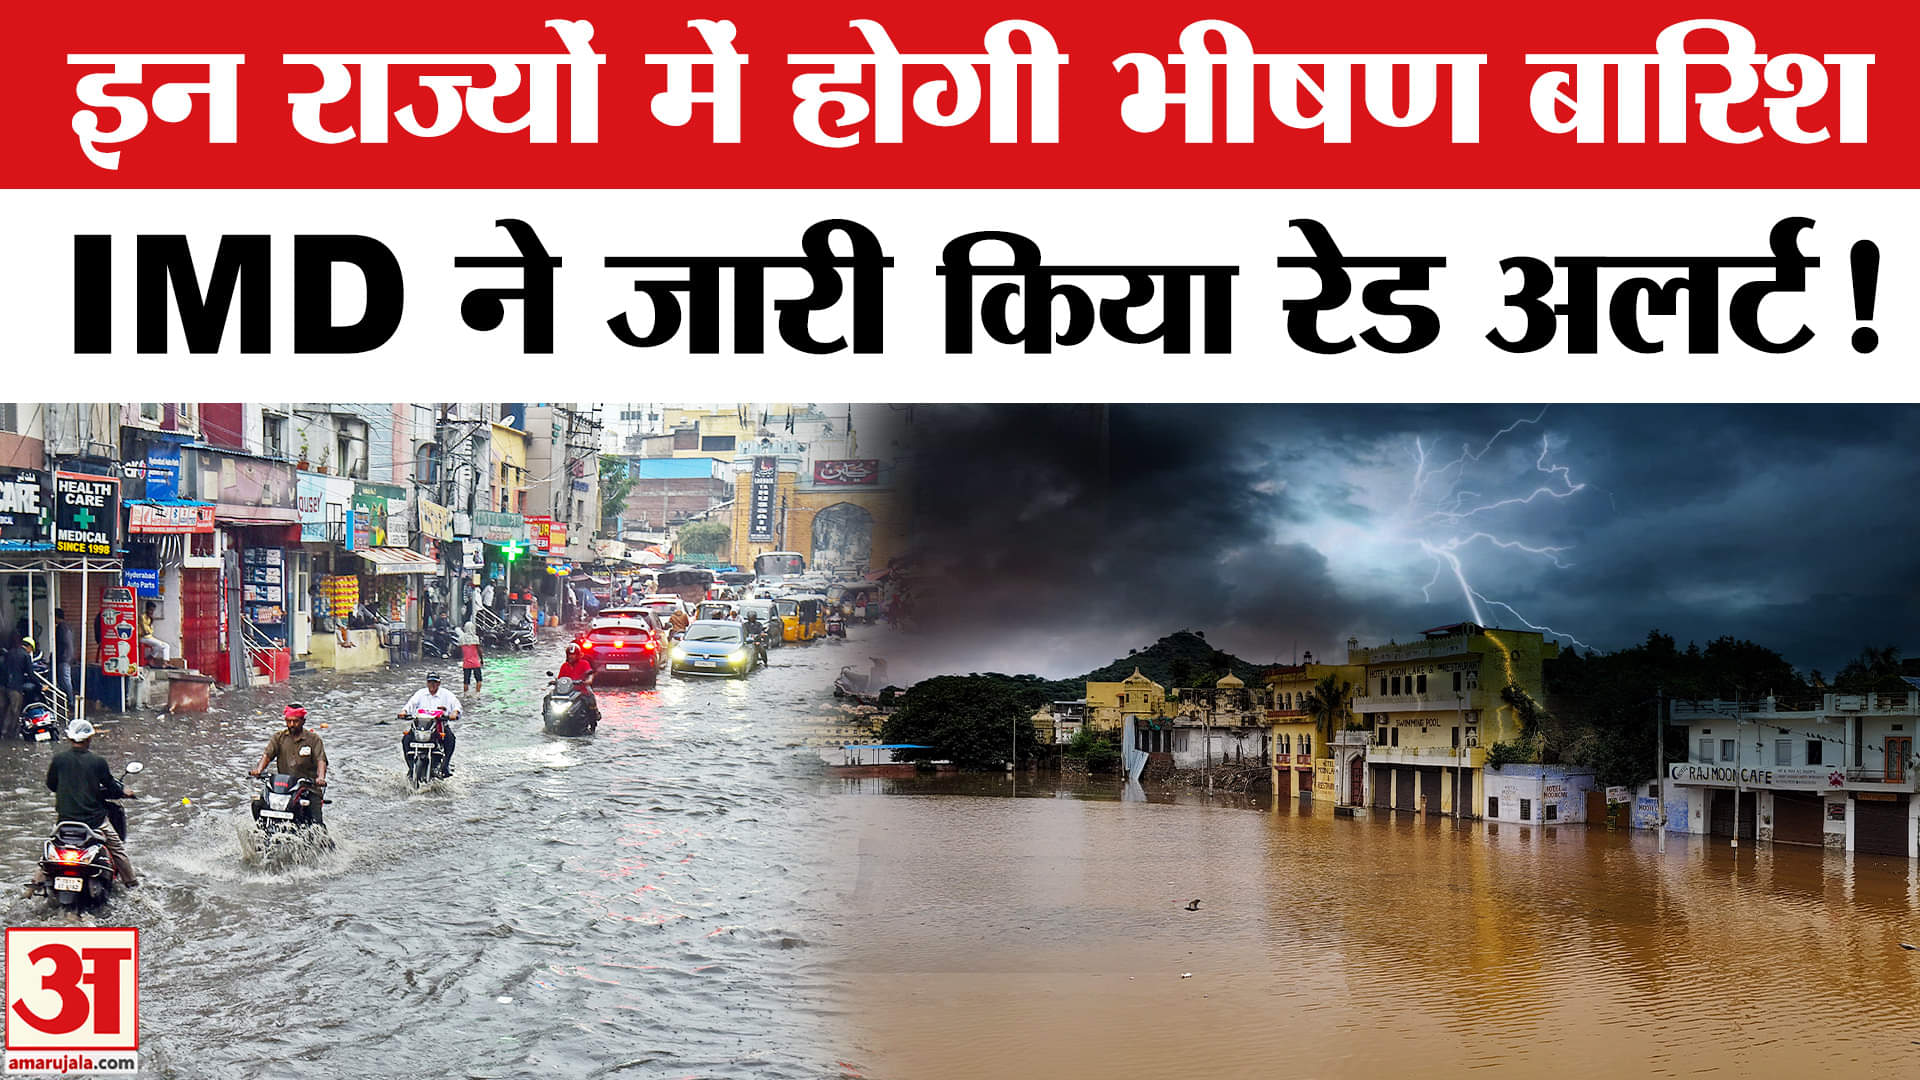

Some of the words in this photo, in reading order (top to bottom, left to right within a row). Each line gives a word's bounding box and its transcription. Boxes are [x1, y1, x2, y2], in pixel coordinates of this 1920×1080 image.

[58, 480, 112, 496] HEALTH
[65, 493, 105, 507] CARE
[58, 529, 109, 544] MEDICAL
[57, 541, 86, 553] SINCE
[88, 543, 111, 555] 1998
[125, 571, 156, 580] Hyderabad
[140, 581, 155, 589] Parts
[1396, 719, 1425, 728] SWIMMING
[1426, 718, 1441, 727] POOL
[1689, 766, 1709, 781] RAJ
[1711, 766, 1737, 782] MOON
[1740, 768, 1773, 784] CAFE
